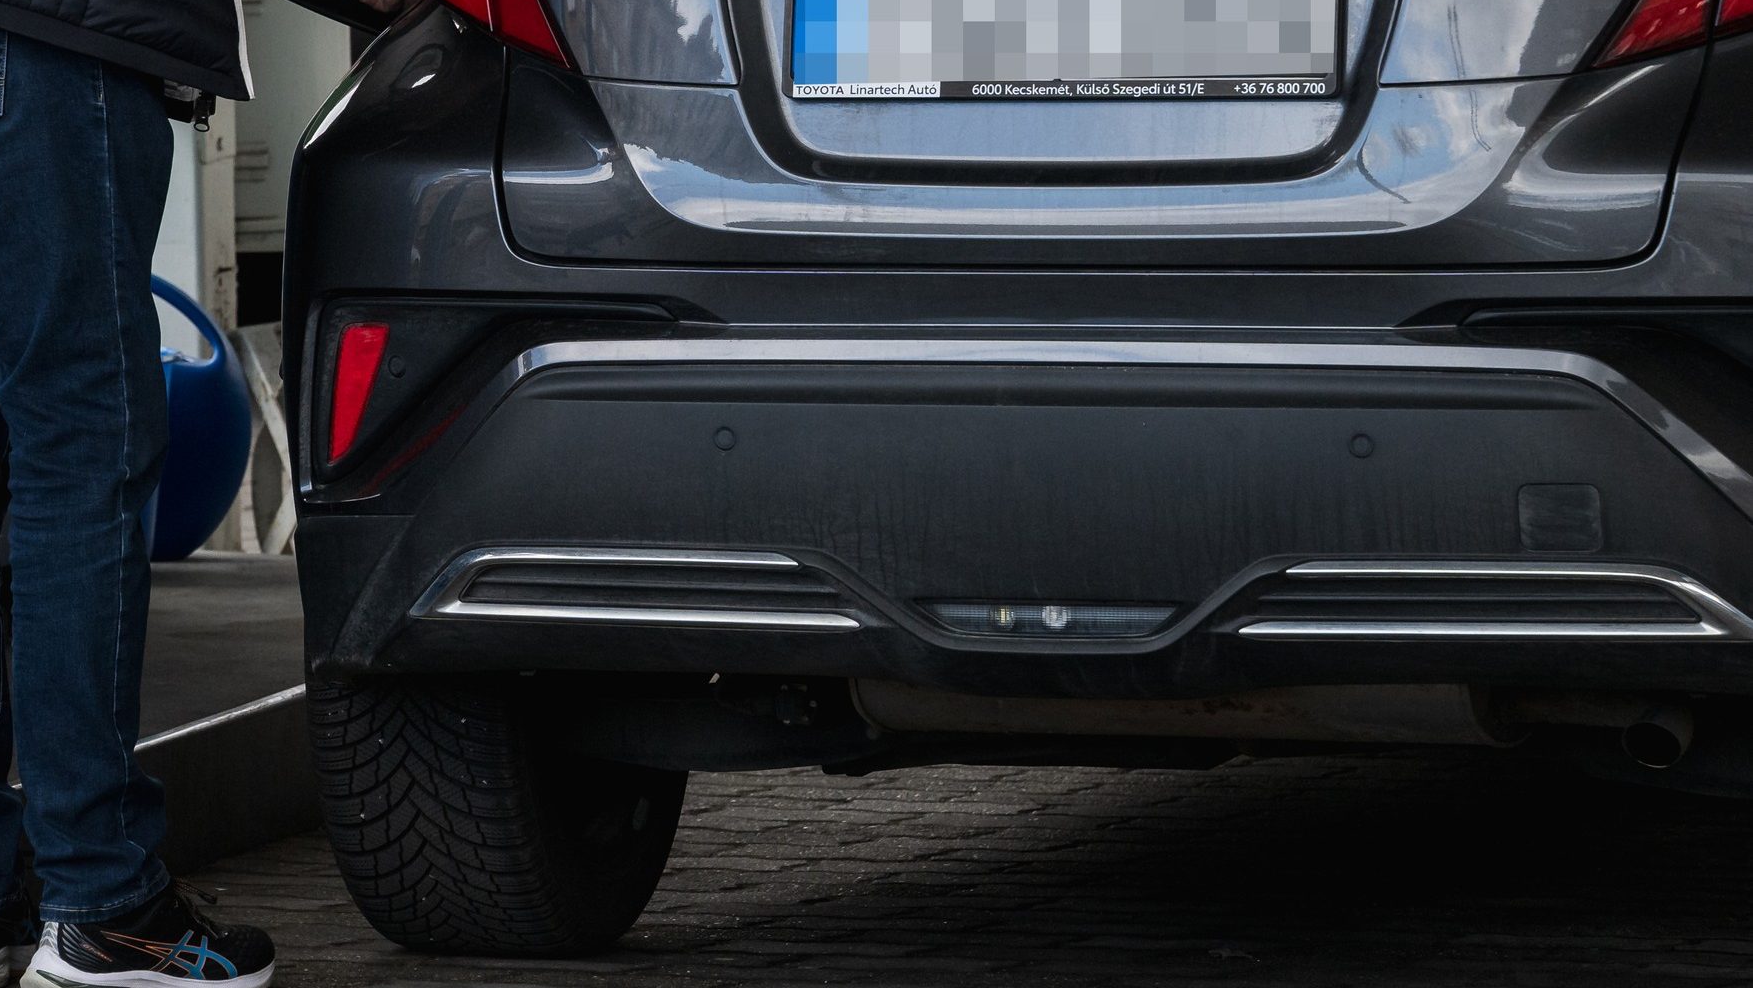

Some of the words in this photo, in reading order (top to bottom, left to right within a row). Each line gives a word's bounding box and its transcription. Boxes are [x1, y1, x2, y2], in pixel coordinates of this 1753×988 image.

[796, 85, 844, 95] TOYOTA
[850, 84, 905, 96] Linartech
[907, 84, 937, 96] Autó
[972, 84, 1002, 95] 6000
[1004, 84, 1073, 97] Kecskemét,
[1075, 83, 1110, 95] Külső
[1112, 83, 1160, 98] Szegedi
[1163, 83, 1176, 95] út
[1178, 83, 1205, 97] 51/E
[1234, 83, 1256, 95] +36
[1259, 83, 1274, 94] 76
[1277, 83, 1299, 94] 800
[1302, 83, 1325, 94] 700
